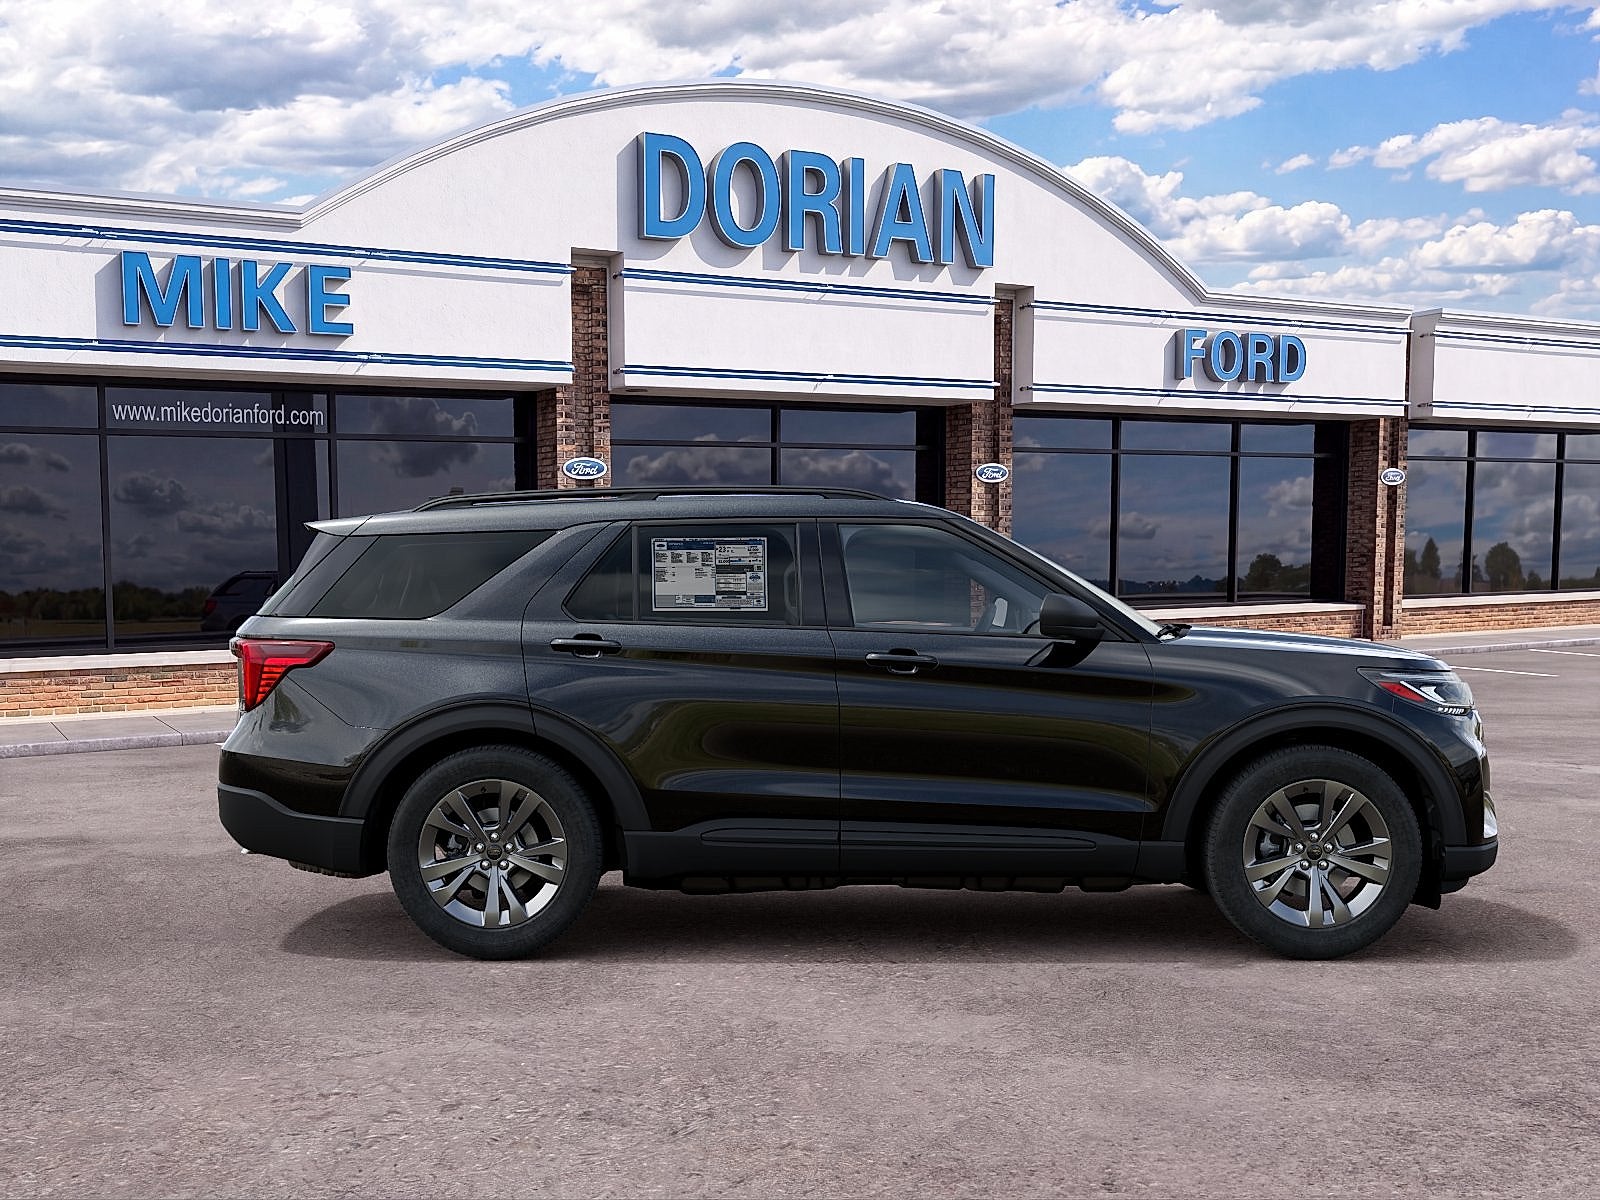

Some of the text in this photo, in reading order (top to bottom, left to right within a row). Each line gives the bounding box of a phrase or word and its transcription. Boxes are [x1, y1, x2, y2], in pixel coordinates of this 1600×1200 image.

[638, 132, 995, 268] DORIAN
[121, 251, 354, 336] MIKE
[1178, 329, 1307, 383] FORD
[111, 401, 324, 426] www.mikedorianford.com
[571, 462, 599, 475] Ford
[981, 467, 1004, 479] Ford
